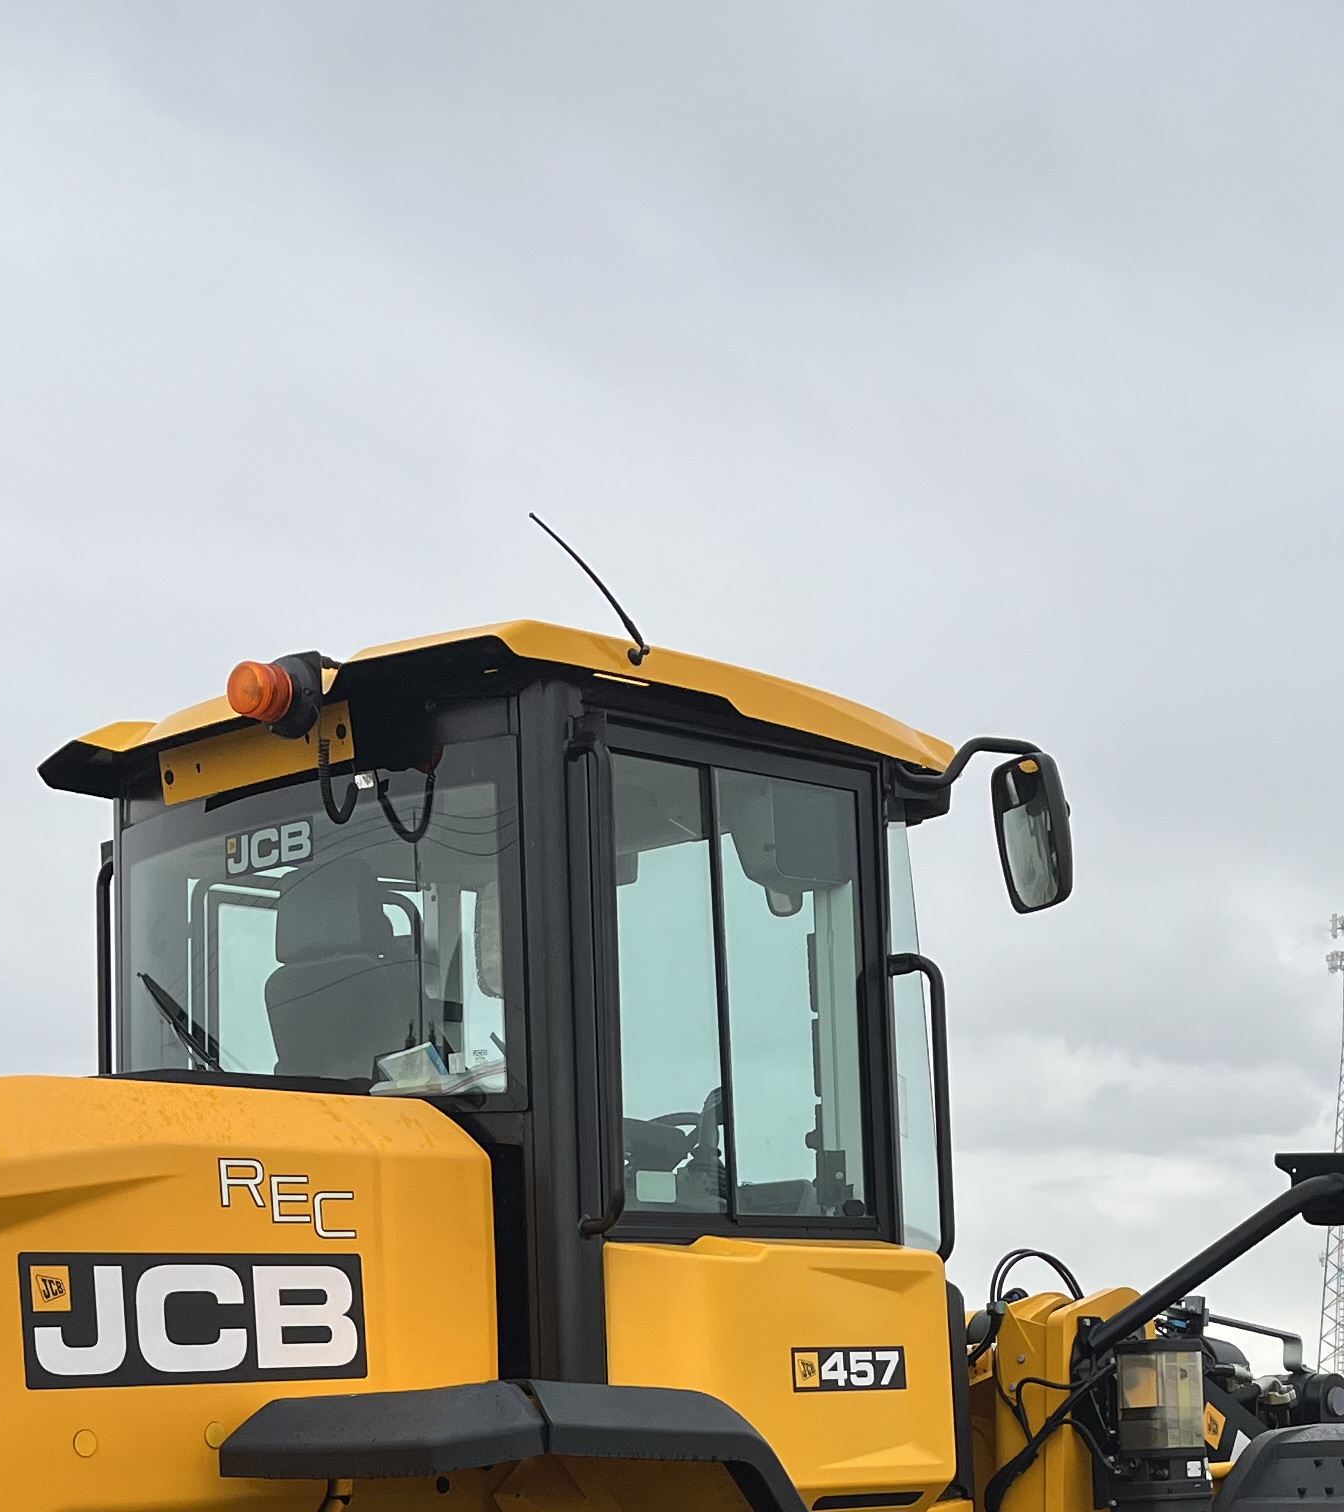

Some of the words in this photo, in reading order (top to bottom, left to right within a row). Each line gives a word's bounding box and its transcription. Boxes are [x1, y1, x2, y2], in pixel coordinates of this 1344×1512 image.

[227, 821, 311, 874] JCB
[217, 1157, 358, 1239] REC
[41, 1278, 64, 1299] JCB
[33, 1264, 359, 1376] JCB
[821, 1351, 900, 1387] 457
